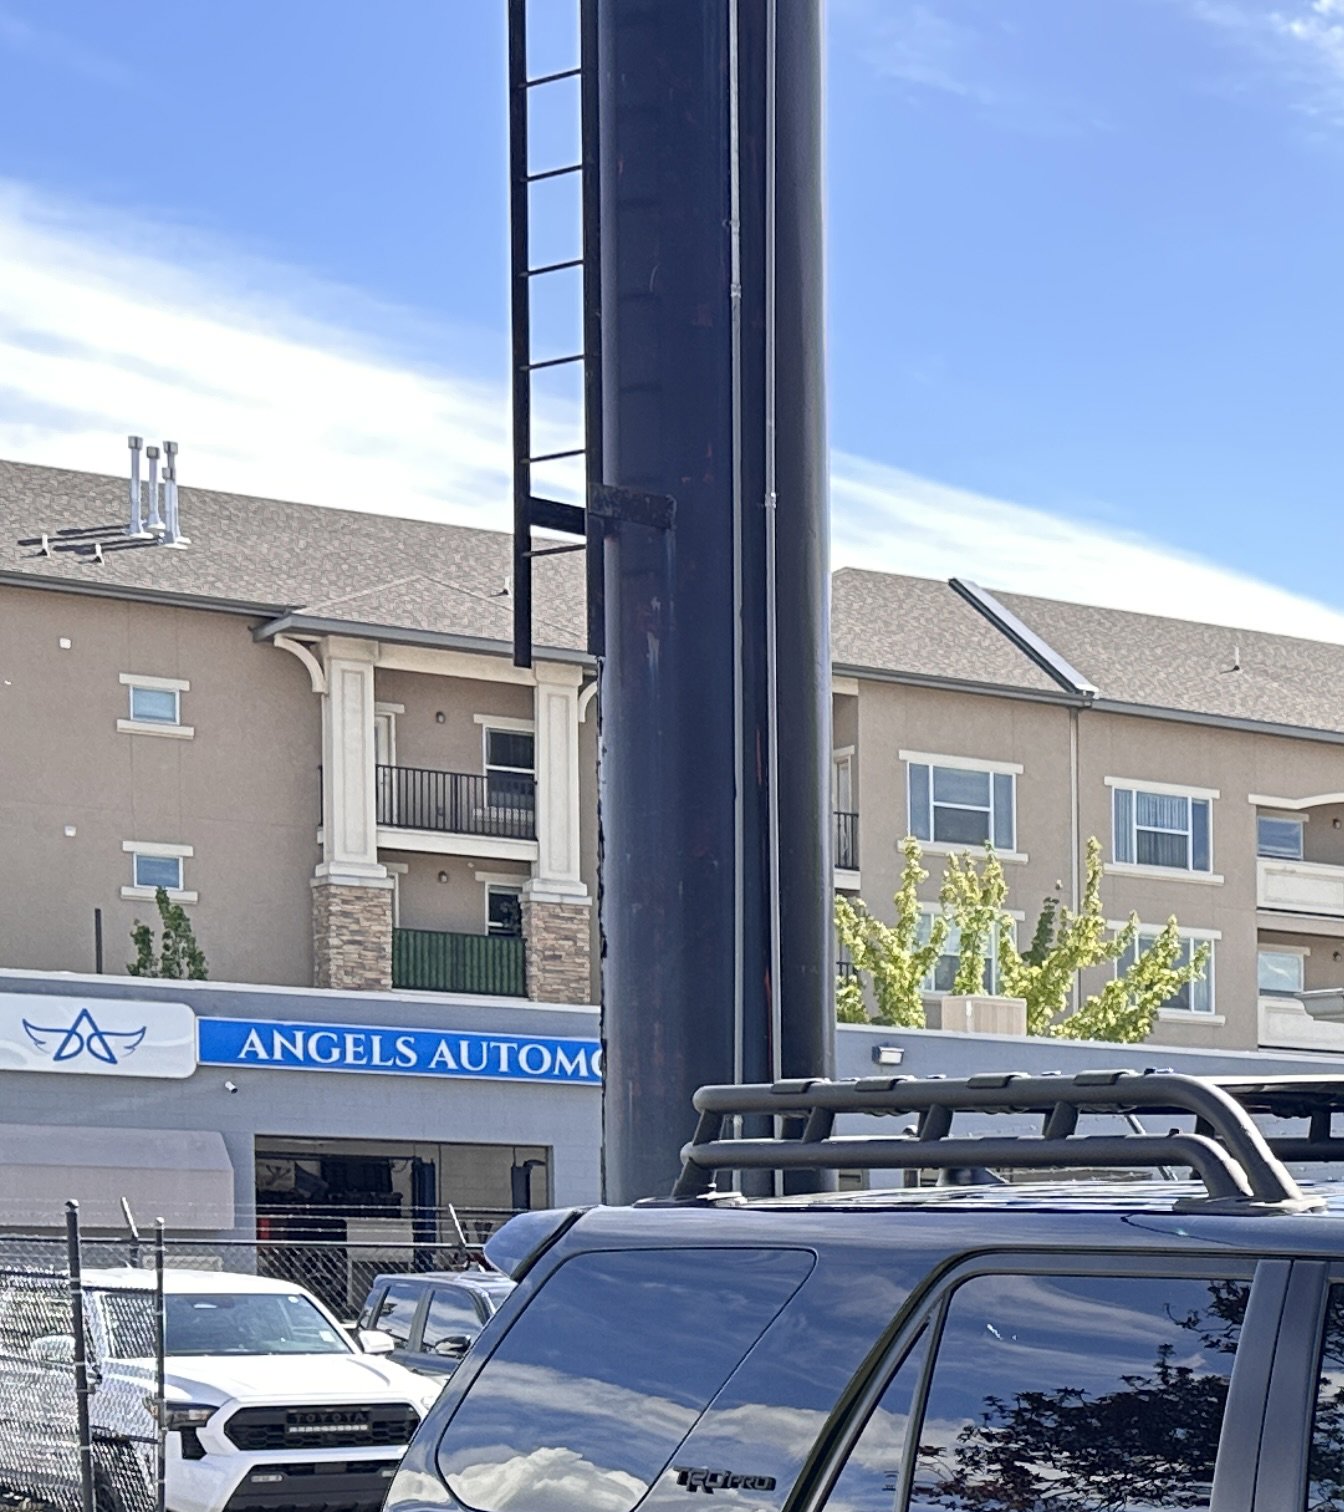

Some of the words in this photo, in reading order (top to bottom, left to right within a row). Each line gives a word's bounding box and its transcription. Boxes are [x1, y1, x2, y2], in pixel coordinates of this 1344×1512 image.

[238, 1027, 417, 1068] ANGELS
[428, 1037, 603, 1079] AUTOM
[672, 1465, 730, 1495] TRD
[727, 1474, 777, 1492] PRO
